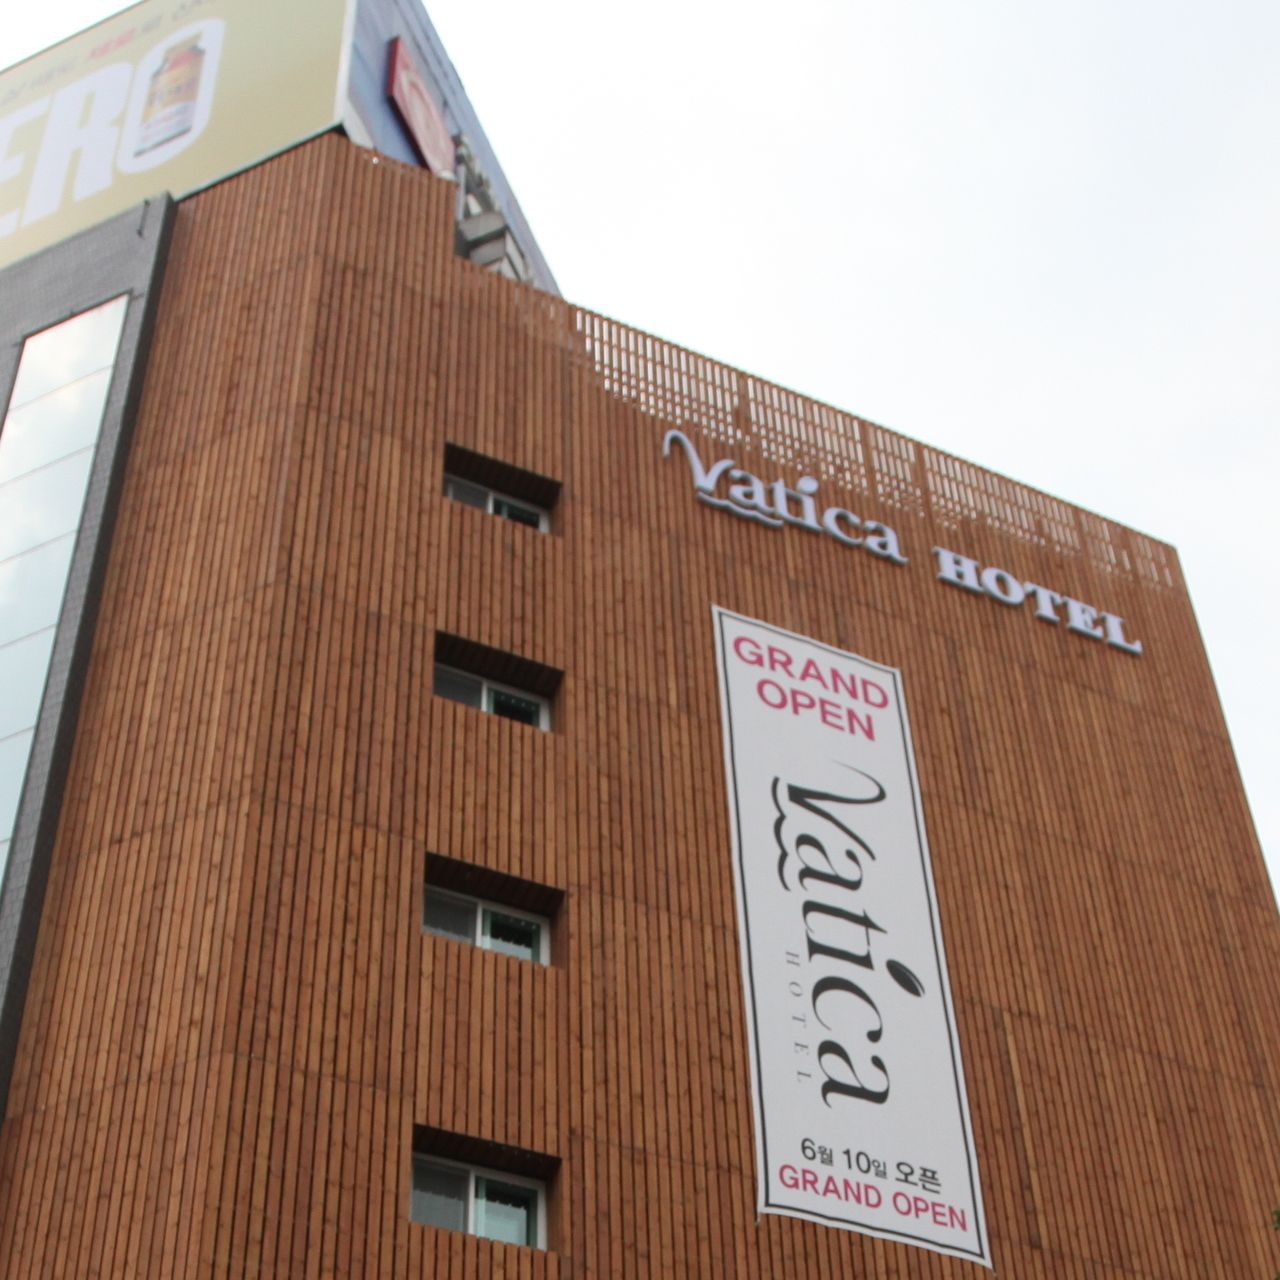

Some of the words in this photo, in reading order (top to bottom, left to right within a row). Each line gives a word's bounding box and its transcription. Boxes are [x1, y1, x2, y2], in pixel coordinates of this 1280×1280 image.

[663, 429, 908, 565] Vatica
[932, 546, 1142, 655] HOTEL
[733, 635, 890, 710] GRAND
[757, 679, 876, 741] OPEN
[772, 759, 925, 1108] Vatica
[784, 951, 813, 1083] HOTEL
[778, 1164, 882, 1210] GRAND
[891, 1190, 968, 1232] OPEN
[800, 1138, 834, 1167] 6월
[841, 1147, 888, 1180] 10일
[894, 1160, 942, 1194] 오픈
